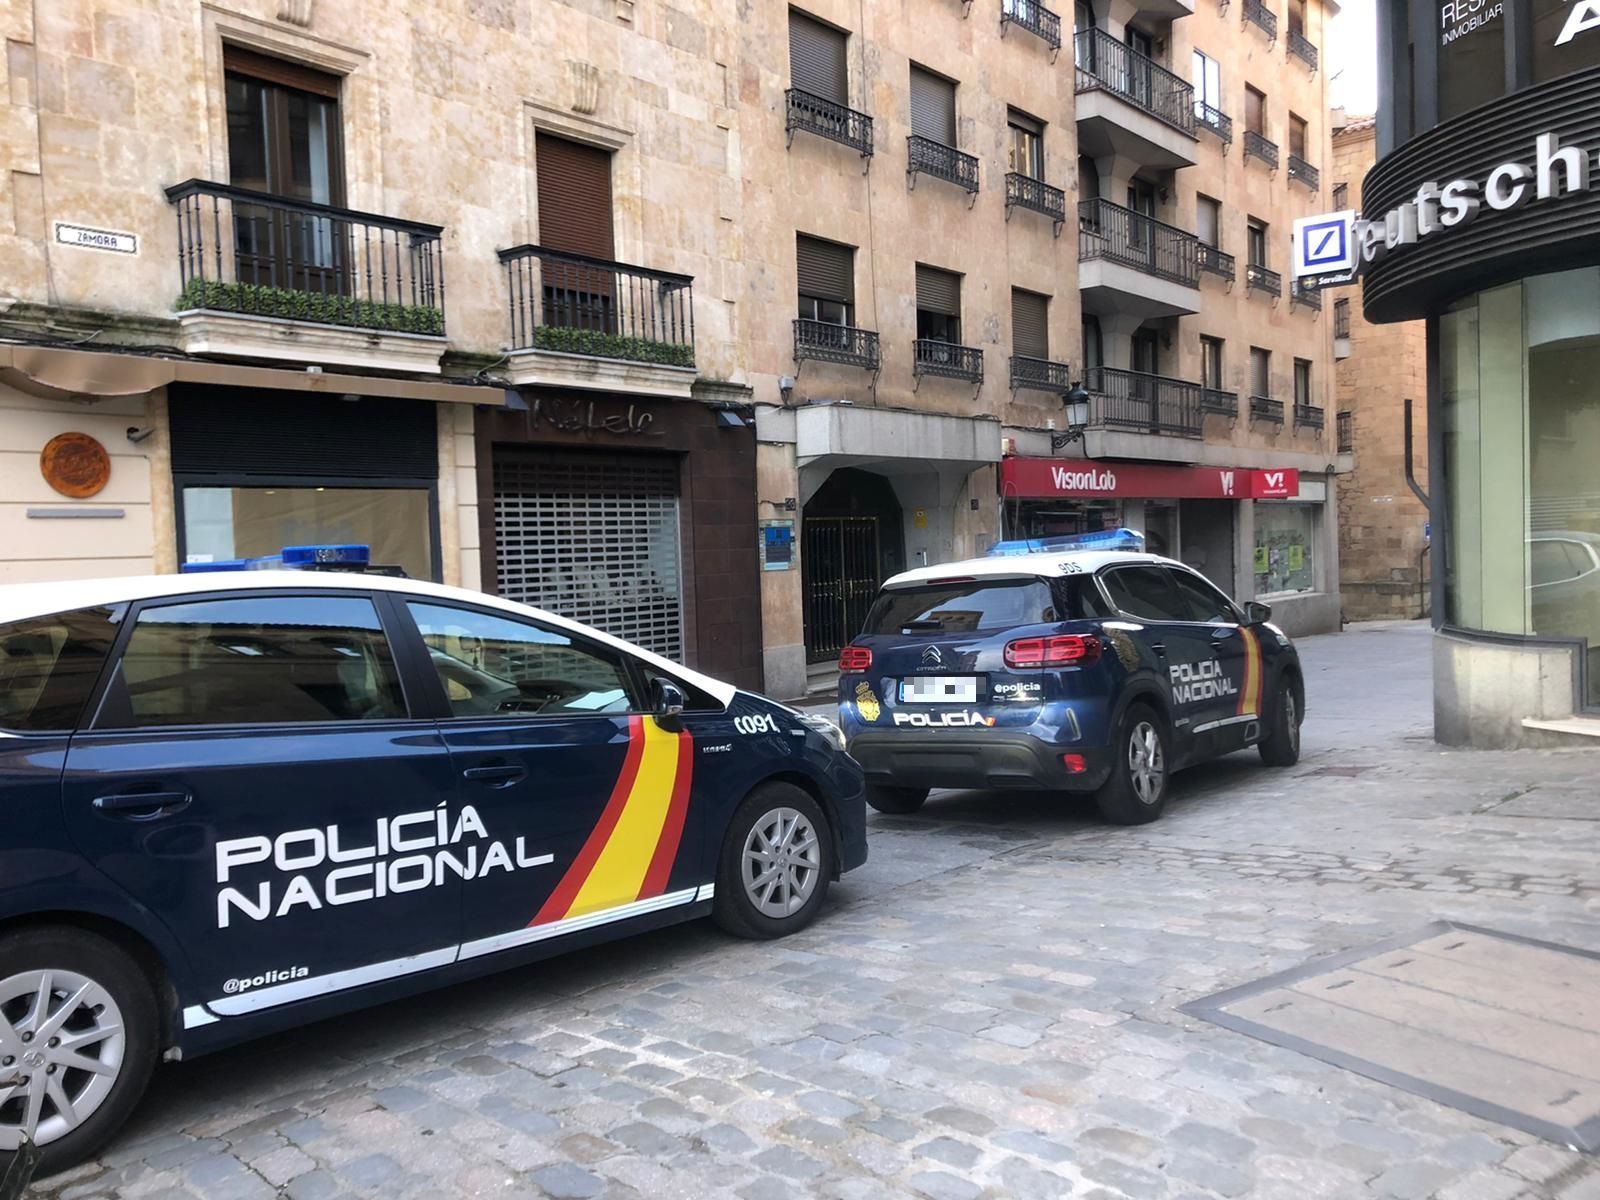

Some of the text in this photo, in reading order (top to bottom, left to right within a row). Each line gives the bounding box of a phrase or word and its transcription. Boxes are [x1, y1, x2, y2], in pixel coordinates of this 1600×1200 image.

[1442, 0, 1488, 29] RES
[77, 231, 118, 247] ZAMORA
[1051, 466, 1117, 491] VisionLab
[994, 682, 1041, 694] @policia
[1172, 677, 1238, 705] NACIONAL
[741, 713, 781, 734] 091
[892, 709, 987, 727] POLICÍA
[215, 800, 488, 883] POLICÍA
[217, 836, 555, 929] NACIONAL
[222, 966, 309, 994] @policia
